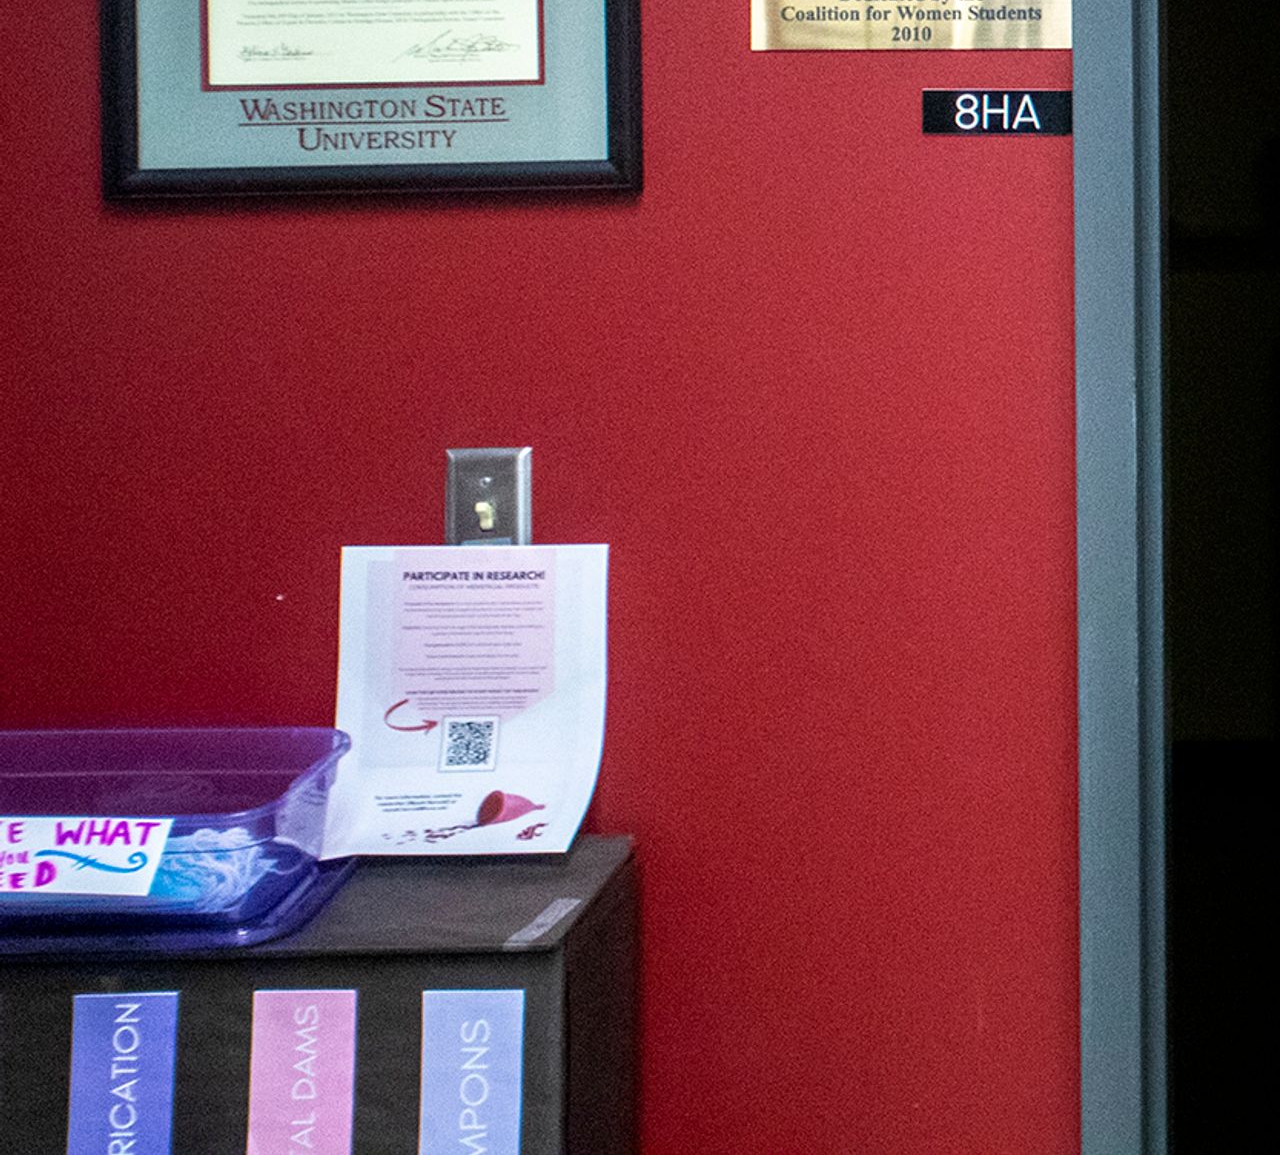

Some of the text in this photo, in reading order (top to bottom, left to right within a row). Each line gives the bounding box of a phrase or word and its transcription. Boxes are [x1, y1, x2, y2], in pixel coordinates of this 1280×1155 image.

[780, 5, 1042, 22] Coalition for Women Students
[891, 26, 932, 42] 2010
[239, 94, 506, 122] WASHINGTON STATE
[955, 93, 1041, 130] 8HA
[297, 127, 457, 152] UNIVERSITY
[403, 570, 545, 581] PARTICIPATE IN RESEARCH!
[0, 819, 162, 846] E WHAT
[289, 1005, 319, 1155] AL DAMS
